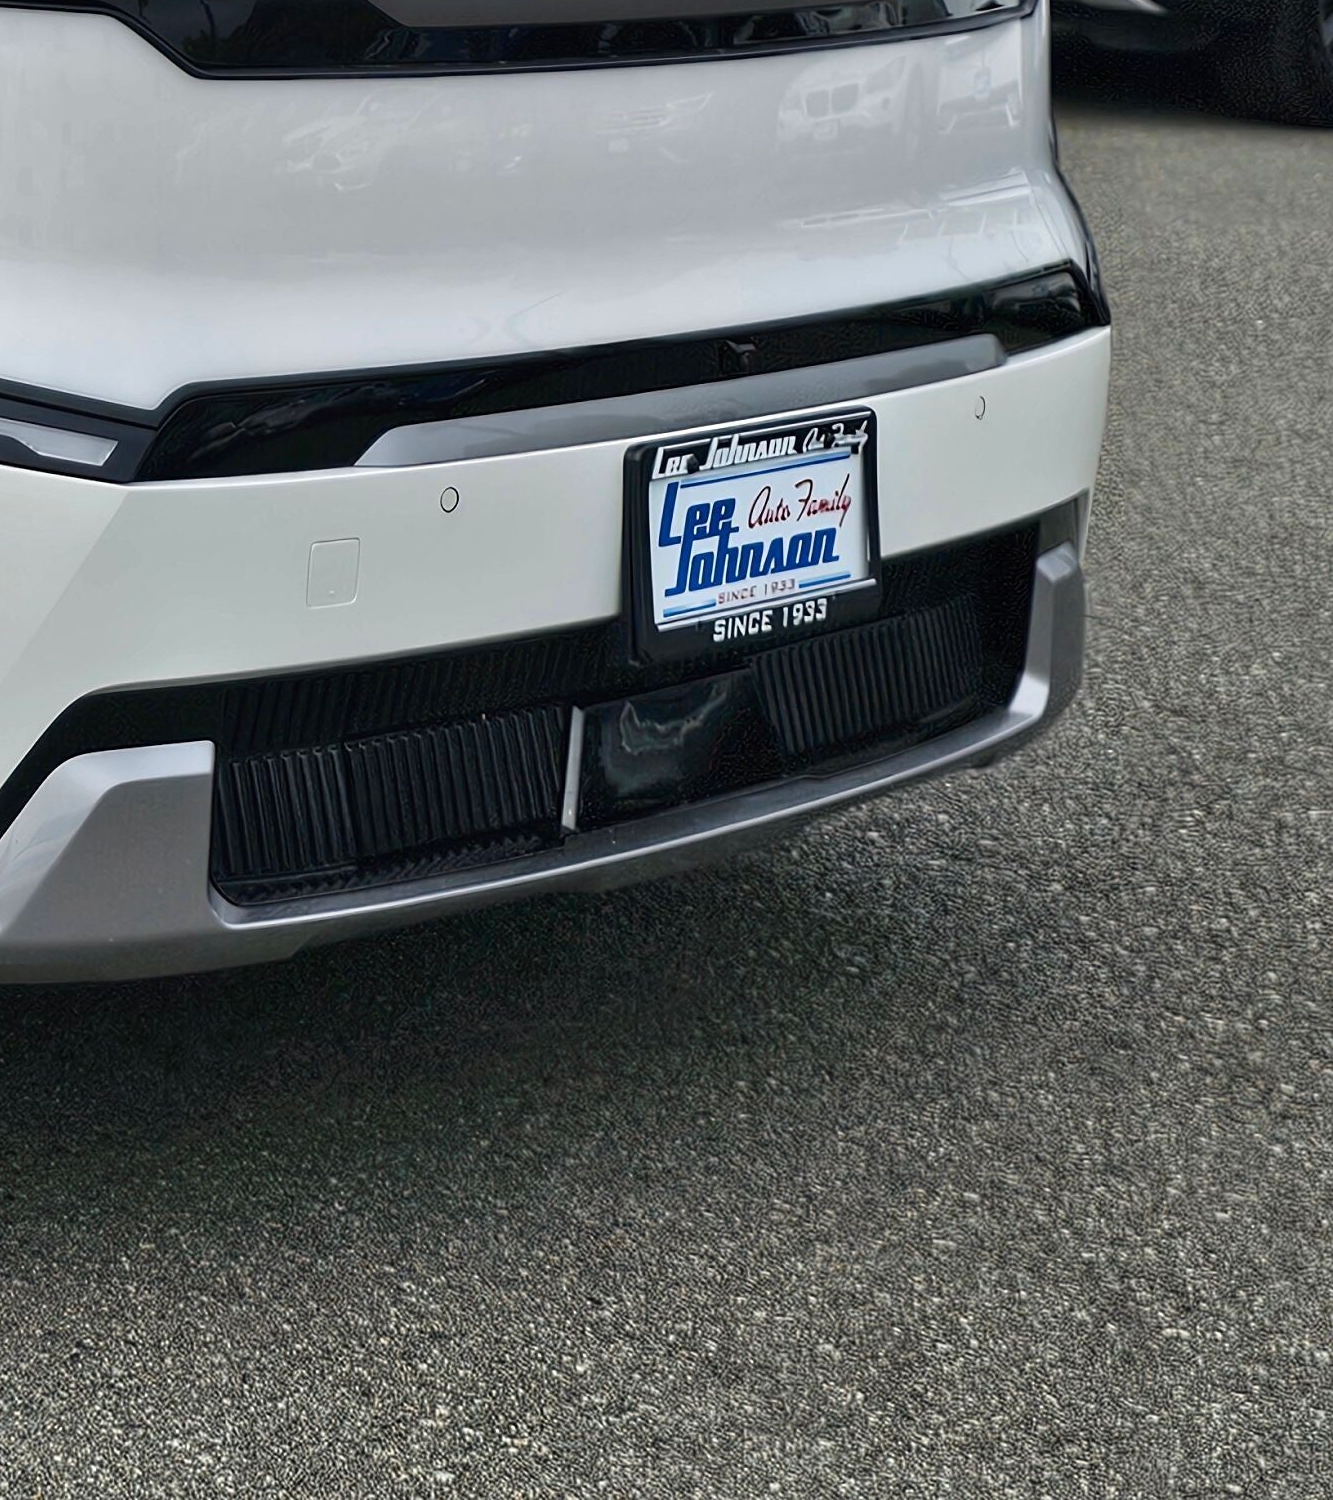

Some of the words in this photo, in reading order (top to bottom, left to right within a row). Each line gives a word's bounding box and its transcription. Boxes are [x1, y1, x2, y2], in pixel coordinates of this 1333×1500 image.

[652, 447, 695, 480] Lee
[698, 433, 798, 471] Johnson
[802, 427, 832, 454] Aut
[659, 482, 739, 547] Lee
[748, 486, 792, 529] Auto
[794, 473, 852, 528] Family
[665, 525, 840, 597] Johnson
[718, 585, 757, 604] SINCE
[764, 578, 796, 597] 1933
[713, 609, 774, 642] SINCE
[782, 597, 828, 629] 1933
